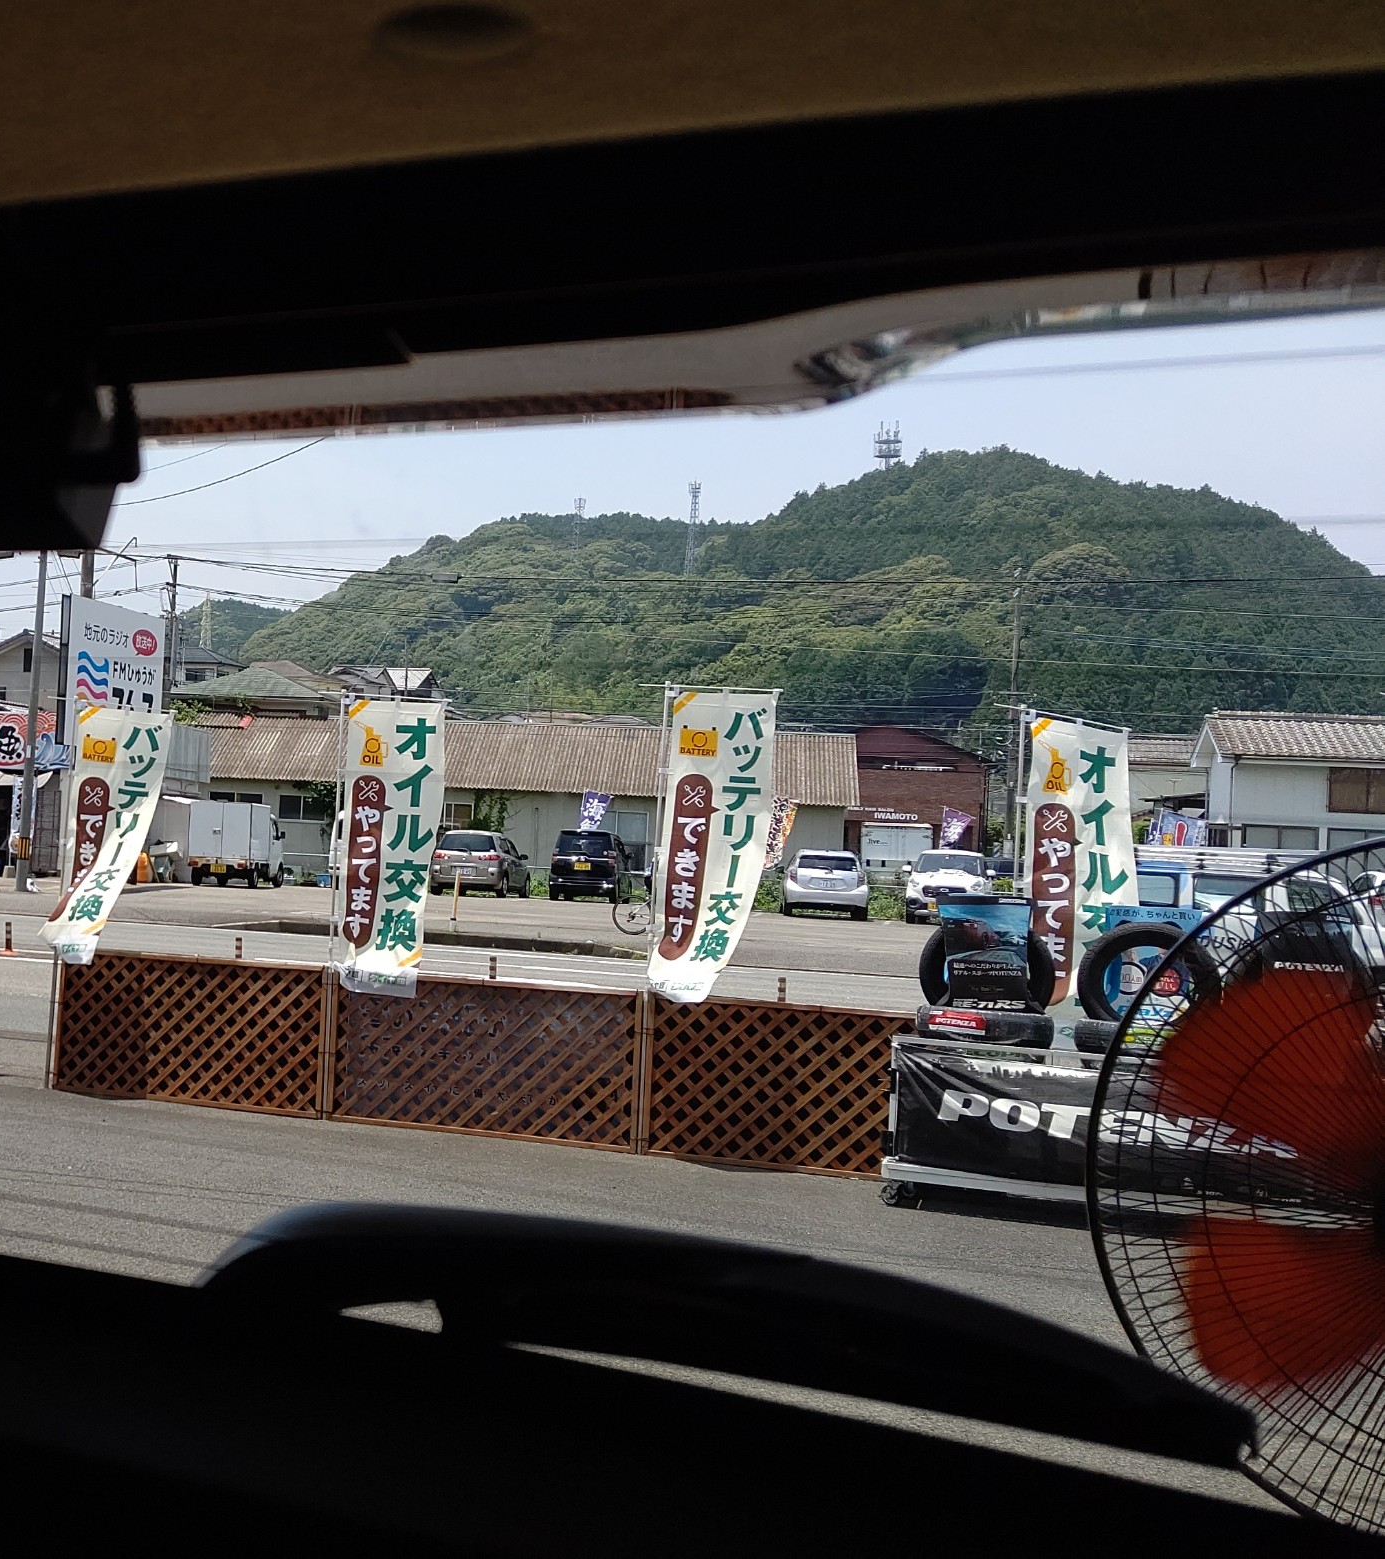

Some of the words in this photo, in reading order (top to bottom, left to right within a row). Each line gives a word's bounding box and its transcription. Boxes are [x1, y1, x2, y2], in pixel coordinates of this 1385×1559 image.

[84, 622, 130, 648] 地元のラジオ
[112, 661, 157, 685] FMひゅうが
[82, 752, 115, 764] BATTERY
[363, 754, 381, 765] OIL
[679, 747, 716, 757] BATTERY
[1046, 780, 1066, 791] OIL
[68, 725, 163, 922] バッテリー交換
[375, 717, 437, 953] オイル交換
[690, 707, 768, 963] バッテリー交換
[874, 812, 919, 821] IWAMOTO
[68, 813, 104, 893] でき
[345, 805, 381, 939] やってます
[1079, 746, 1129, 950] オイル交
[668, 816, 707, 943] できます
[1038, 837, 1072, 979] やってま
[1274, 961, 1345, 973] POTENZA
[935, 1017, 977, 1028] POTENZA
[937, 1089, 1300, 1160] POTENZA
